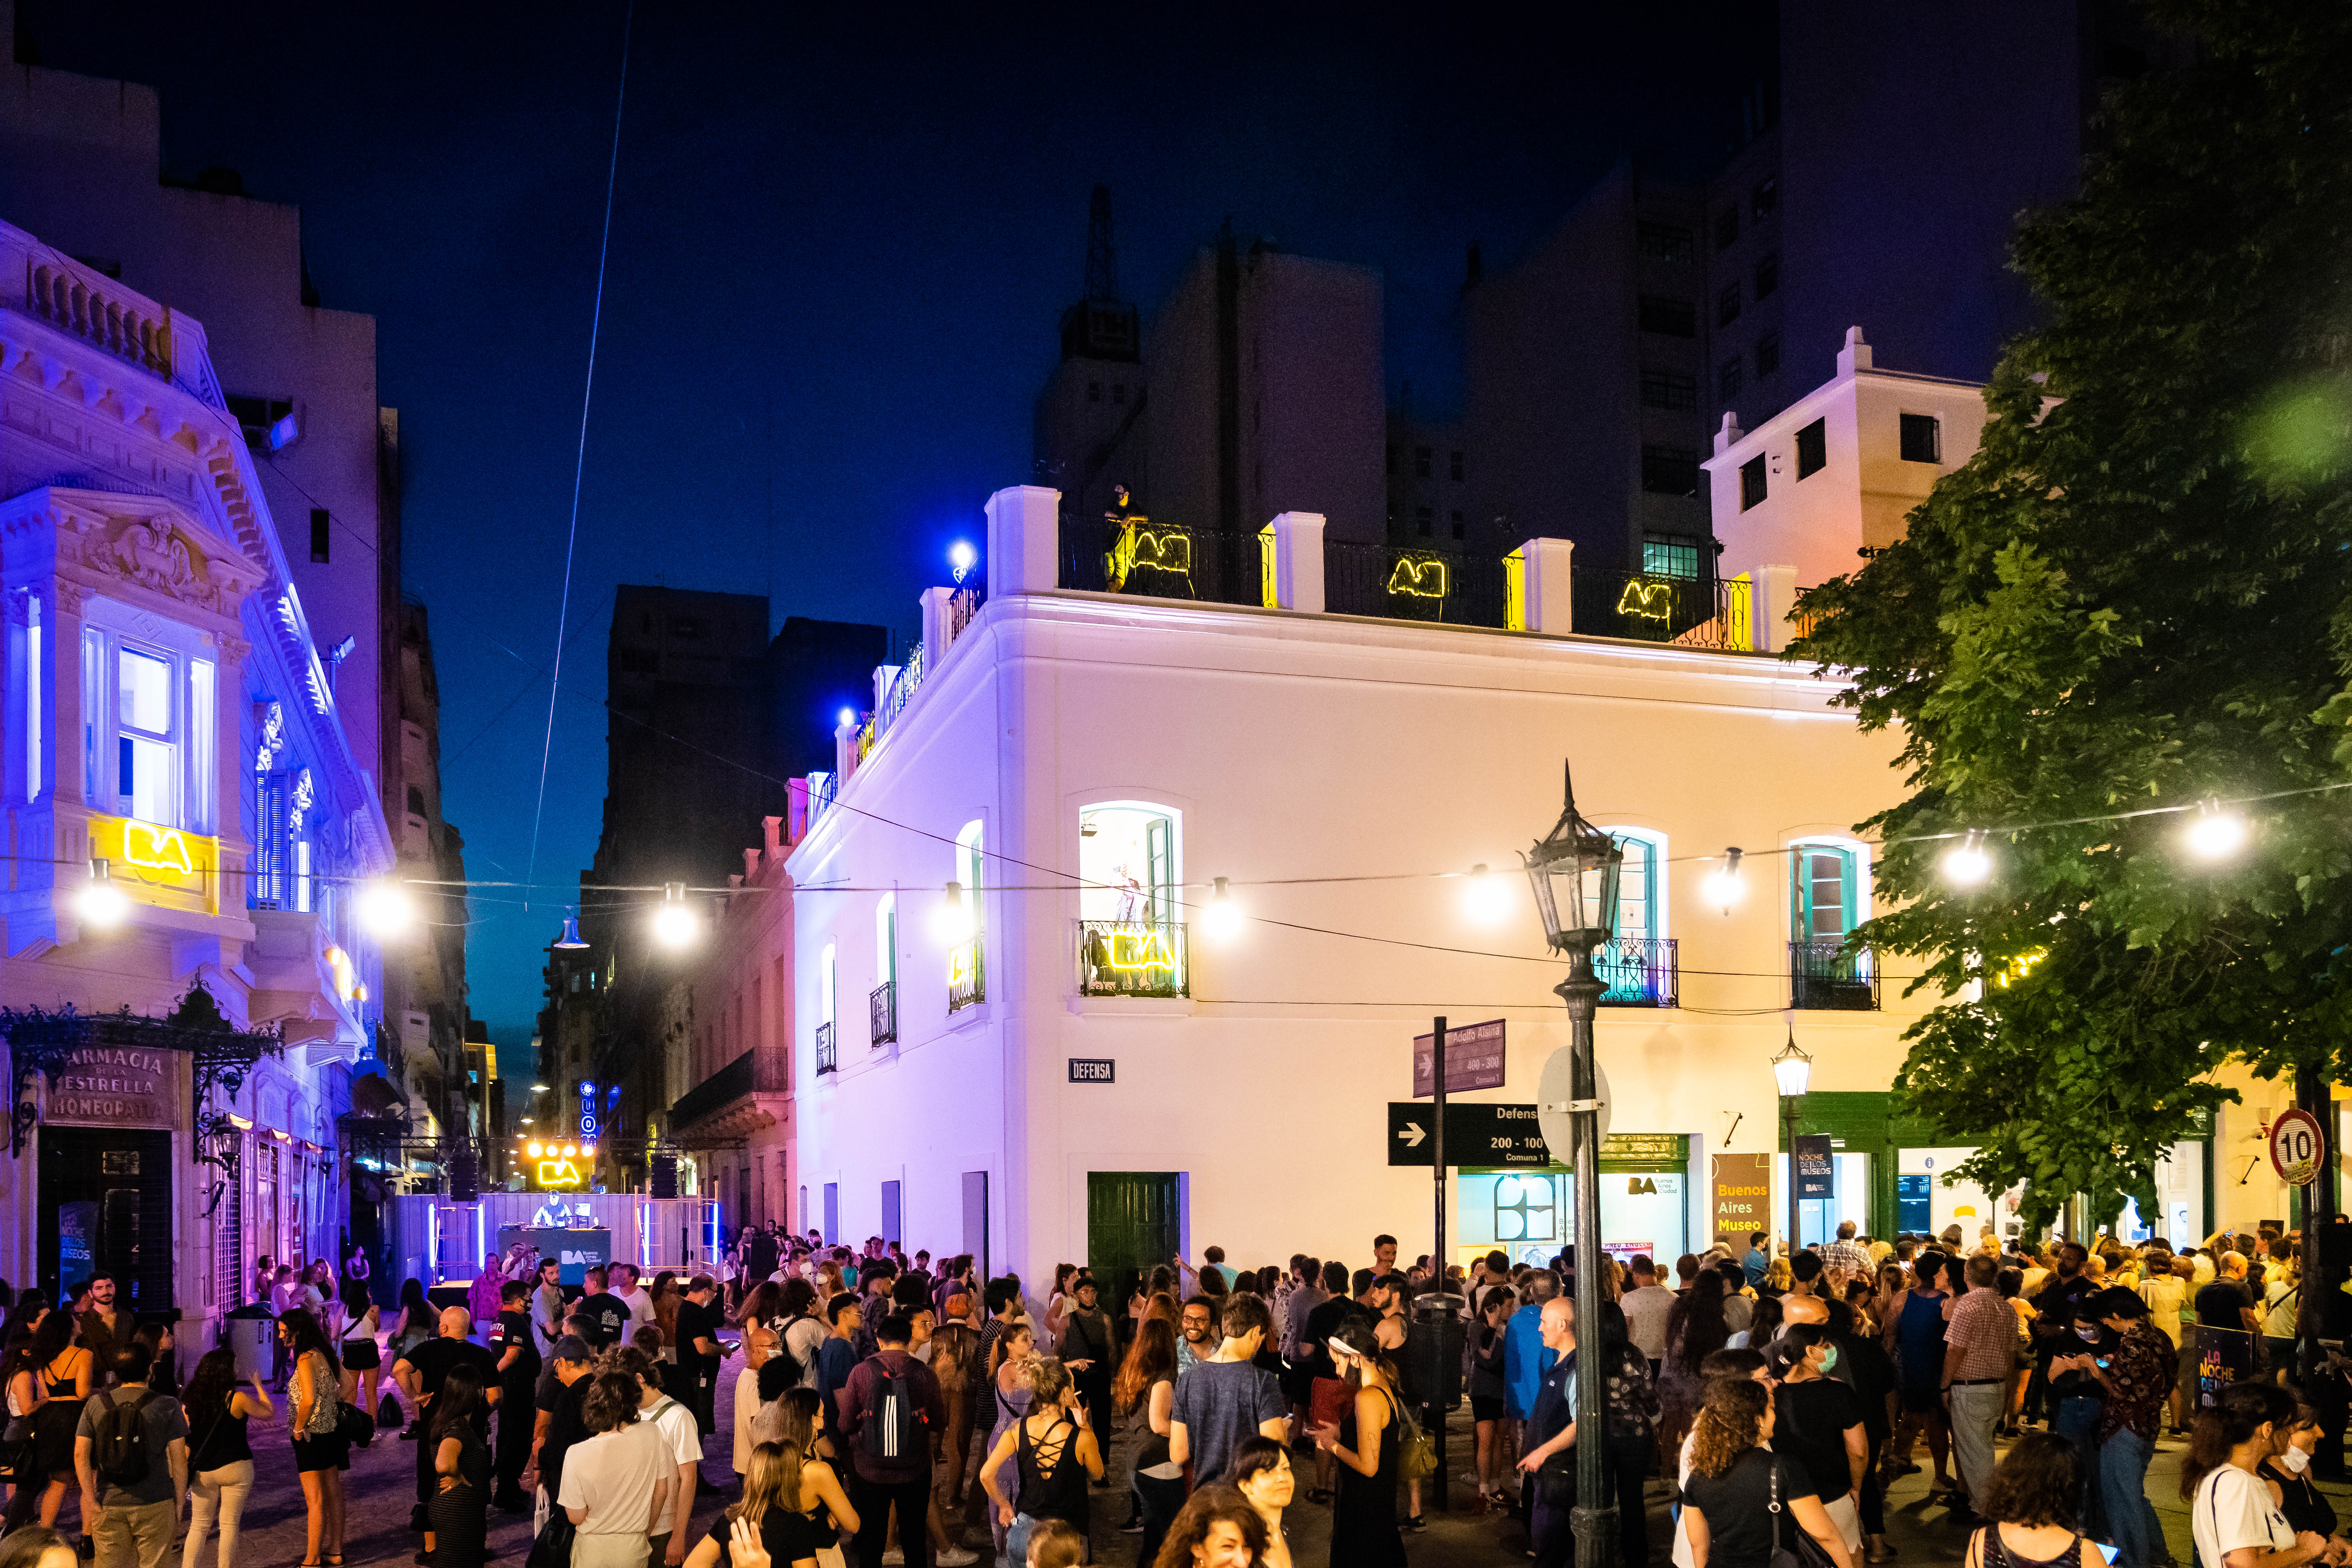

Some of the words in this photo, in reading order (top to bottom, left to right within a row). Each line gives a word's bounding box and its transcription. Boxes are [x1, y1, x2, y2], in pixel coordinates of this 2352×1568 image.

[61, 1048, 163, 1075] ARMACIA
[1467, 1059, 1480, 1070] 400
[1074, 1063, 1111, 1079] DEFENSA
[65, 1076, 155, 1094] ESTRELLA
[1497, 1107, 1537, 1119] Defens
[1491, 1137, 1512, 1148] 200
[1524, 1137, 1543, 1148] 100
[2281, 1131, 2311, 1163] 10
[1798, 1152, 1824, 1161] NOCHE
[1801, 1166, 1831, 1175] MUSEOS
[1628, 1177, 1657, 1194] BA
[1718, 1184, 1767, 1196] Buenos
[1718, 1201, 1752, 1214] Aires
[1719, 1219, 1761, 1231] Museo
[62, 1248, 91, 1260] SEOS
[561, 1250, 586, 1264] BA
[2208, 1350, 2221, 1364] LA
[2200, 1357, 2234, 1383] NOCHE
[2201, 1377, 2213, 1392] DE
